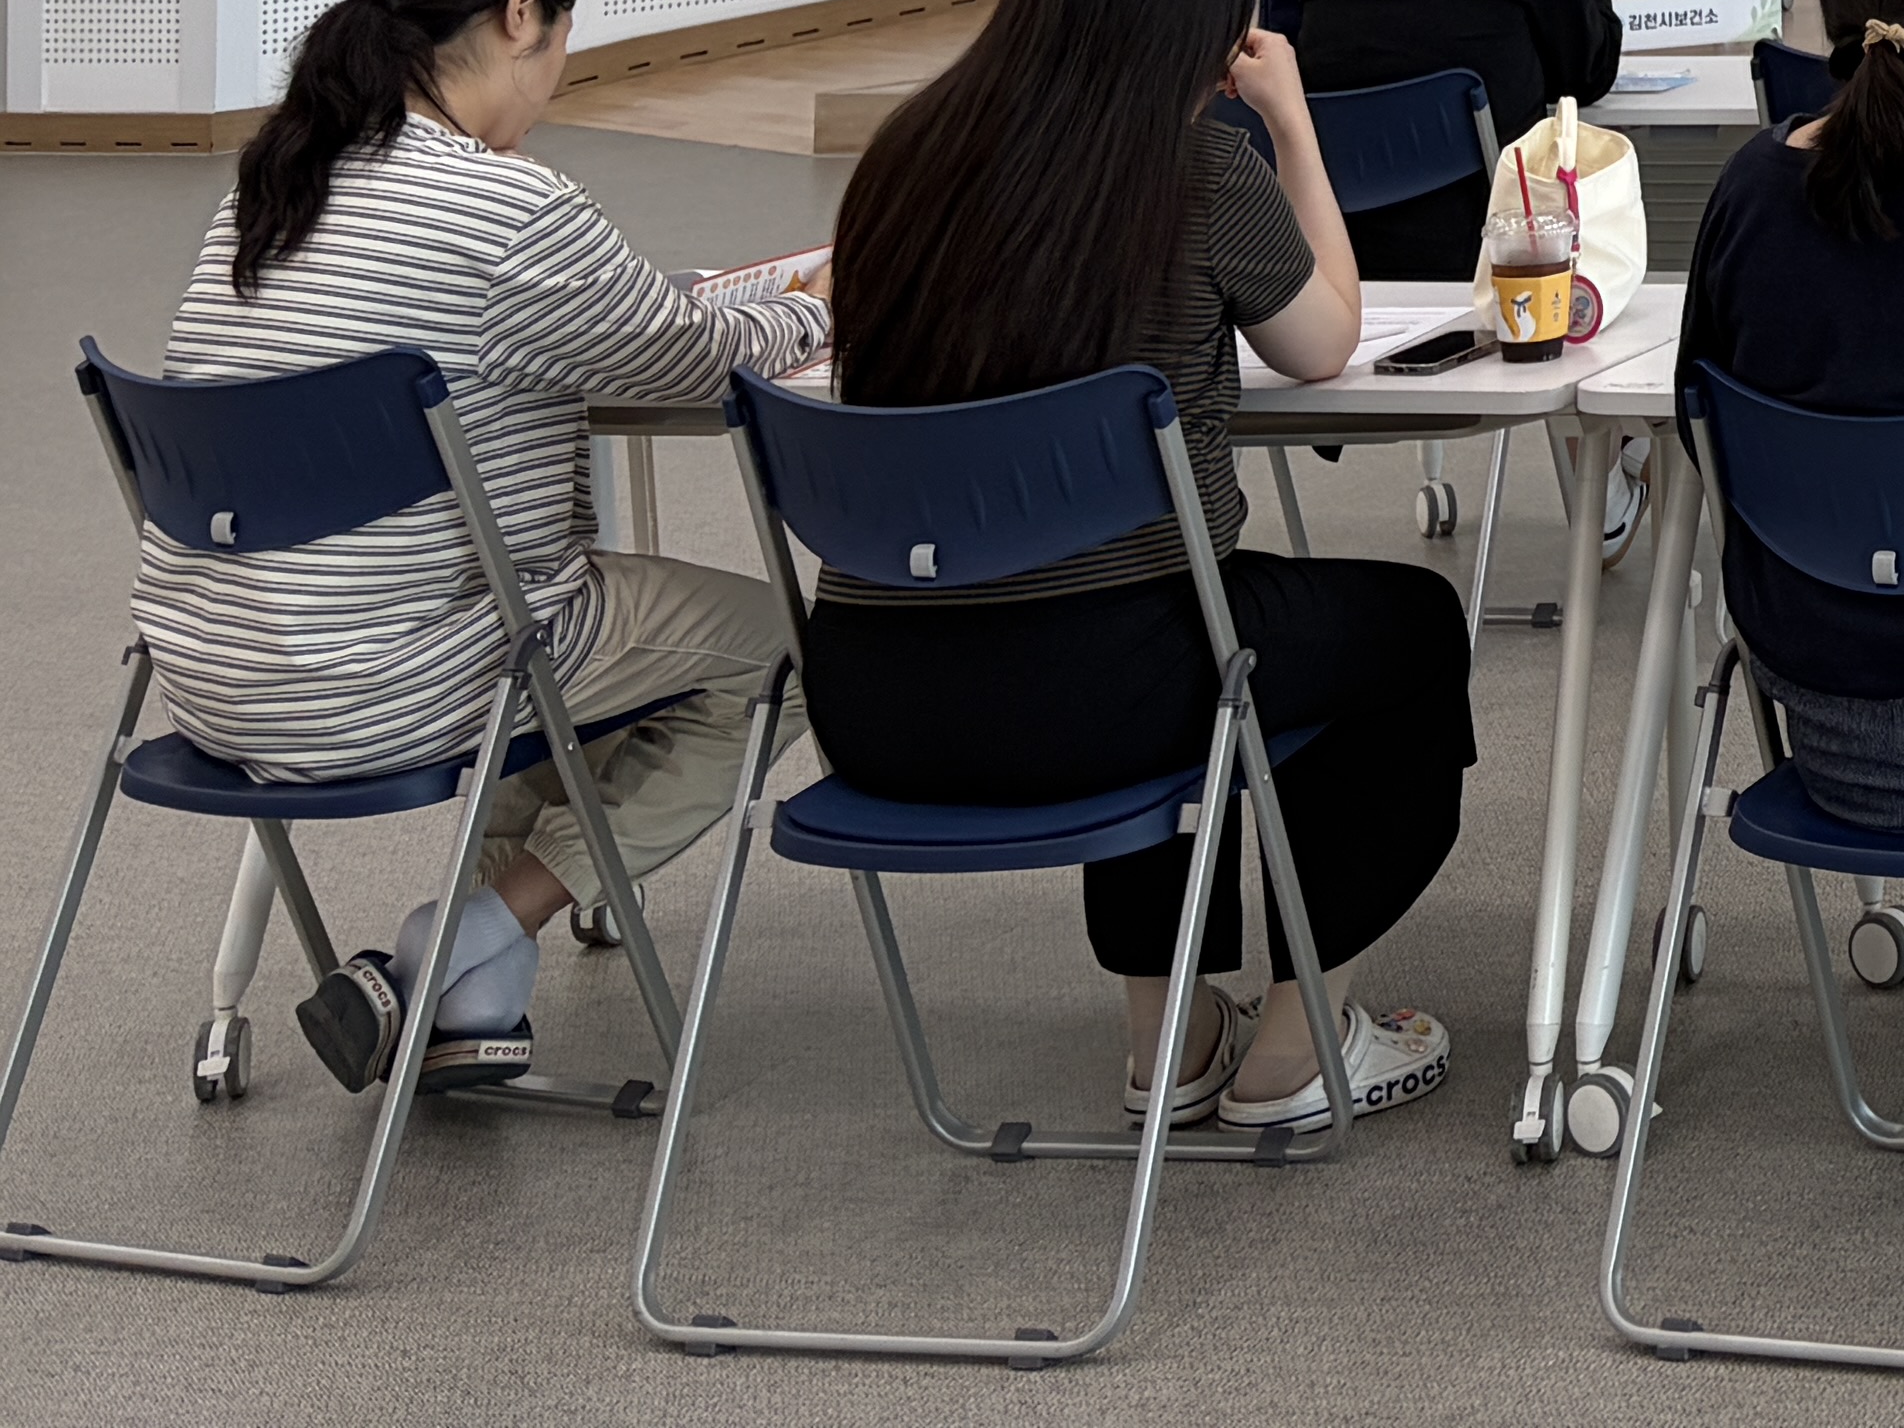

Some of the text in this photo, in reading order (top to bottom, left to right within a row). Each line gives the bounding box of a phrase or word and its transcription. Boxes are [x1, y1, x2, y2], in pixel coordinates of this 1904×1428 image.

[1628, 8, 1719, 31] 김천시보건소
[362, 969, 392, 1008] crocs
[484, 1046, 527, 1056] crocs
[1366, 1055, 1446, 1106] crocs
